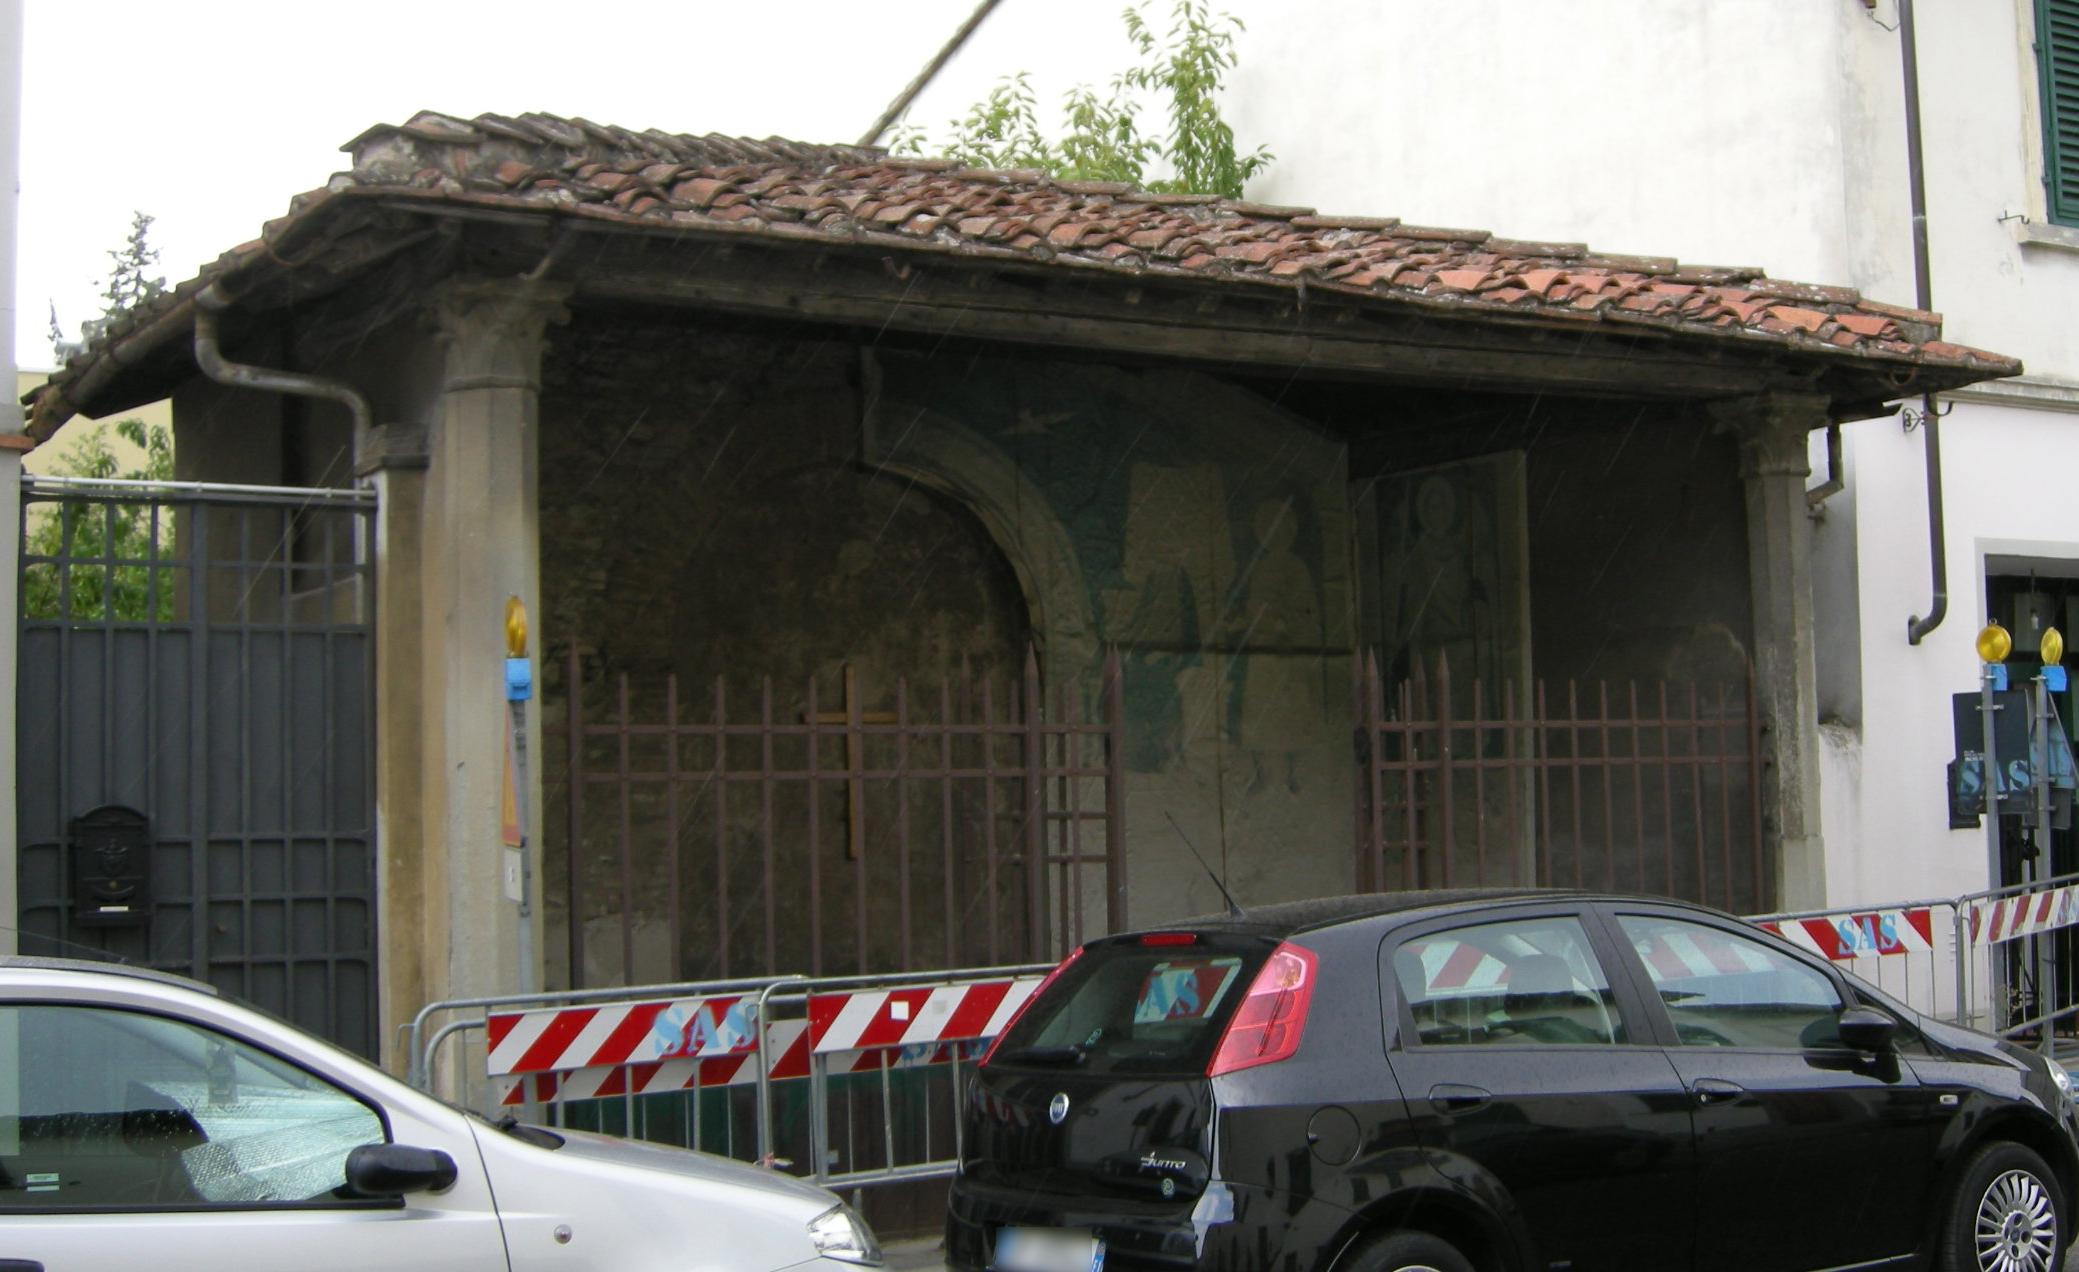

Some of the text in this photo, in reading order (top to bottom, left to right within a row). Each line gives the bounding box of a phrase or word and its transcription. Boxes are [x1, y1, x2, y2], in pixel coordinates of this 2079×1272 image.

[1839, 914, 1897, 954] SAS
[1137, 971, 1199, 1016] AS
[655, 1002, 758, 1055] SAS
